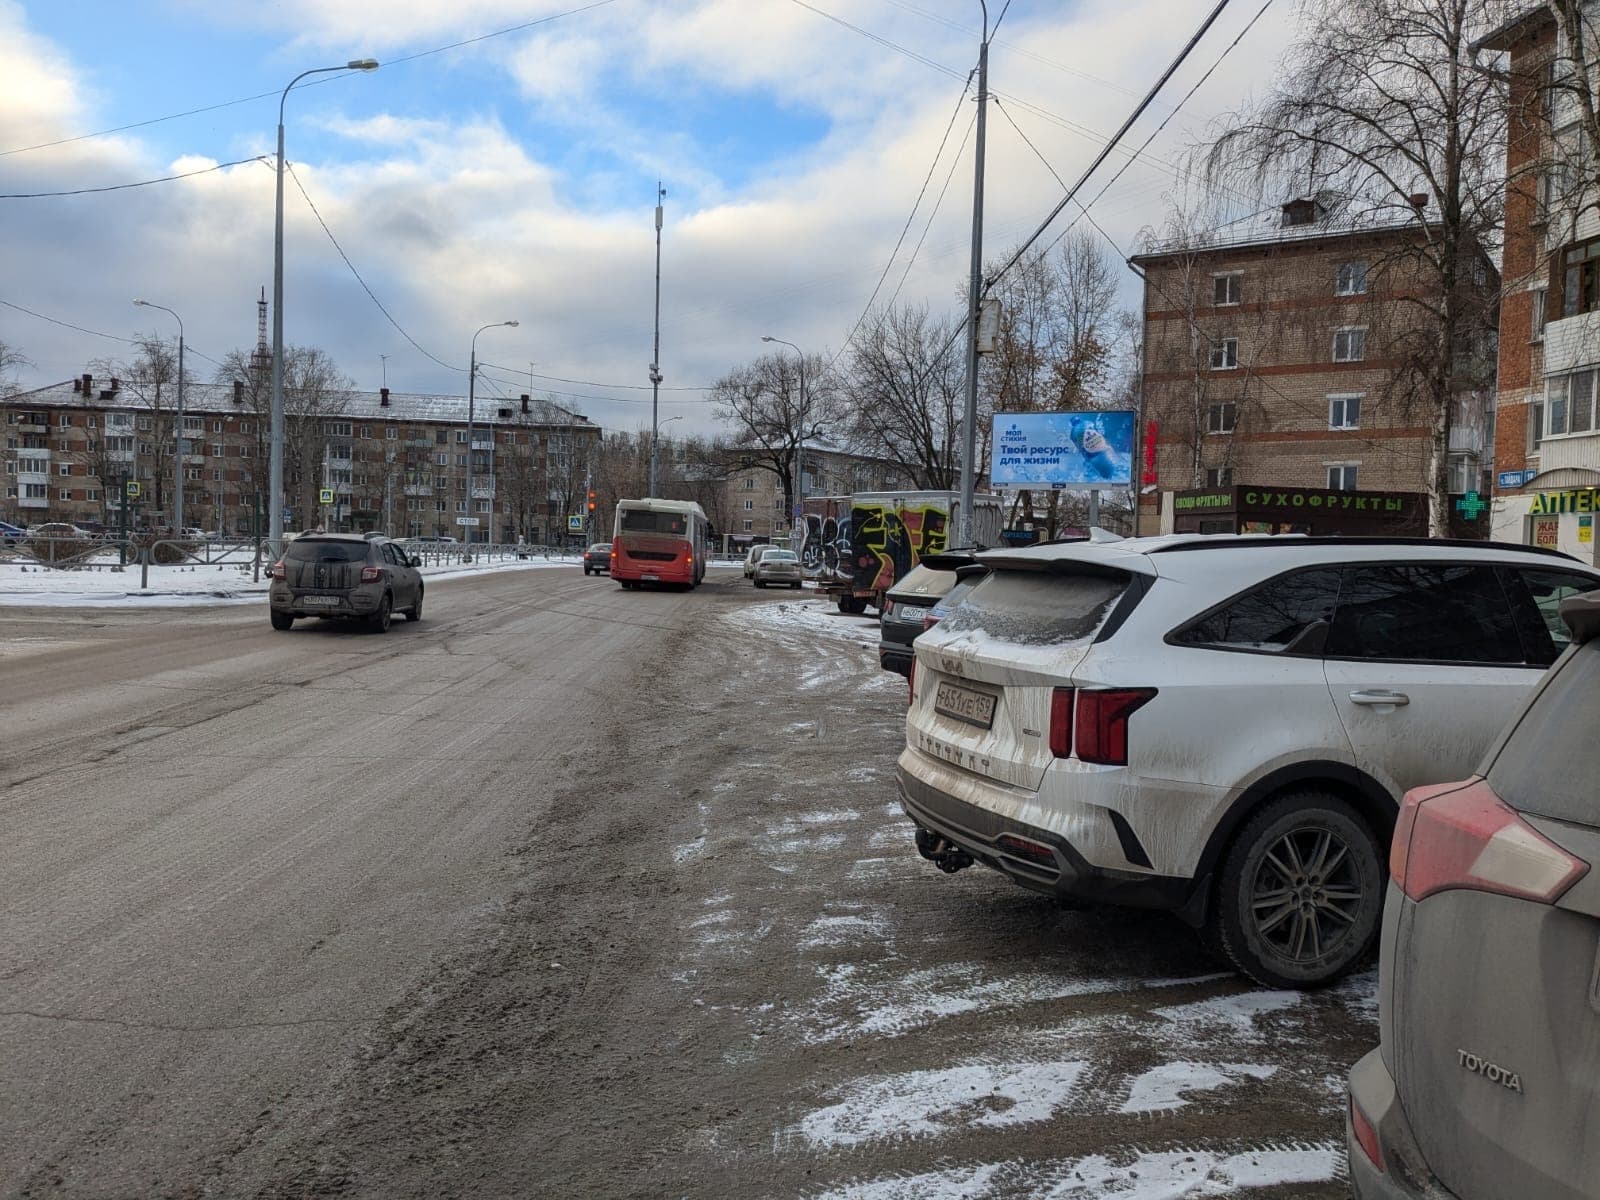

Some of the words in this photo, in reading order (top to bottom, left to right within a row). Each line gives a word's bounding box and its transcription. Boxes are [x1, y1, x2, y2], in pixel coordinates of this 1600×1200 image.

[1000, 445, 1027, 454] Твой
[1030, 446, 1069, 456] ресурс
[1000, 457, 1021, 465] для
[1023, 457, 1060, 465] жизни
[1196, 495, 1221, 507] ФРУКТЫ
[1245, 492, 1402, 511] СУХОФРУКТЫ
[1457, 1048, 1522, 1094] TOYOTA
